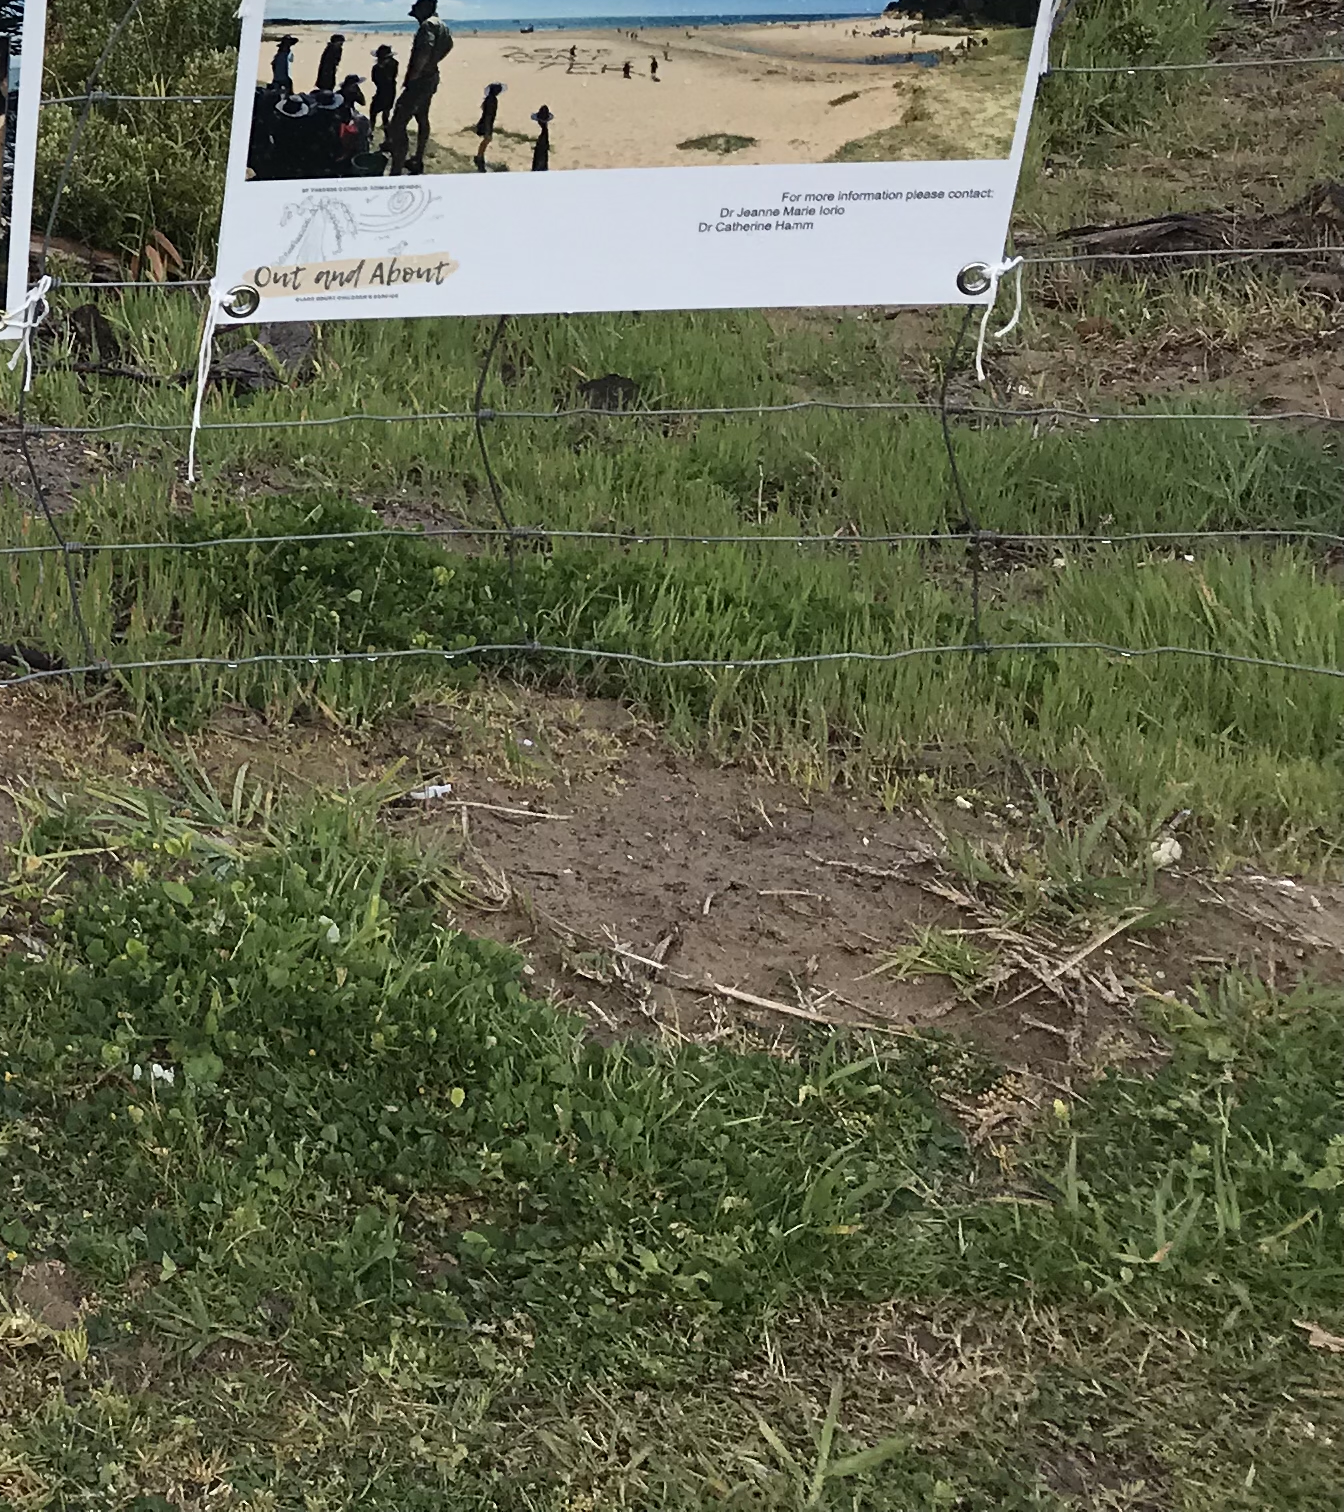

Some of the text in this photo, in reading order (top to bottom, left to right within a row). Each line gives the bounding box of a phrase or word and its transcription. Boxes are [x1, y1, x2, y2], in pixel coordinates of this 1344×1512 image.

[781, 191, 802, 202] For
[804, 193, 834, 202] more
[837, 190, 903, 200] information
[905, 190, 944, 201] please
[719, 205, 845, 218] Dr Jeanne Marie Iorio
[698, 220, 813, 232] Dr Catherine Hamm
[254, 257, 454, 290] Out and About
